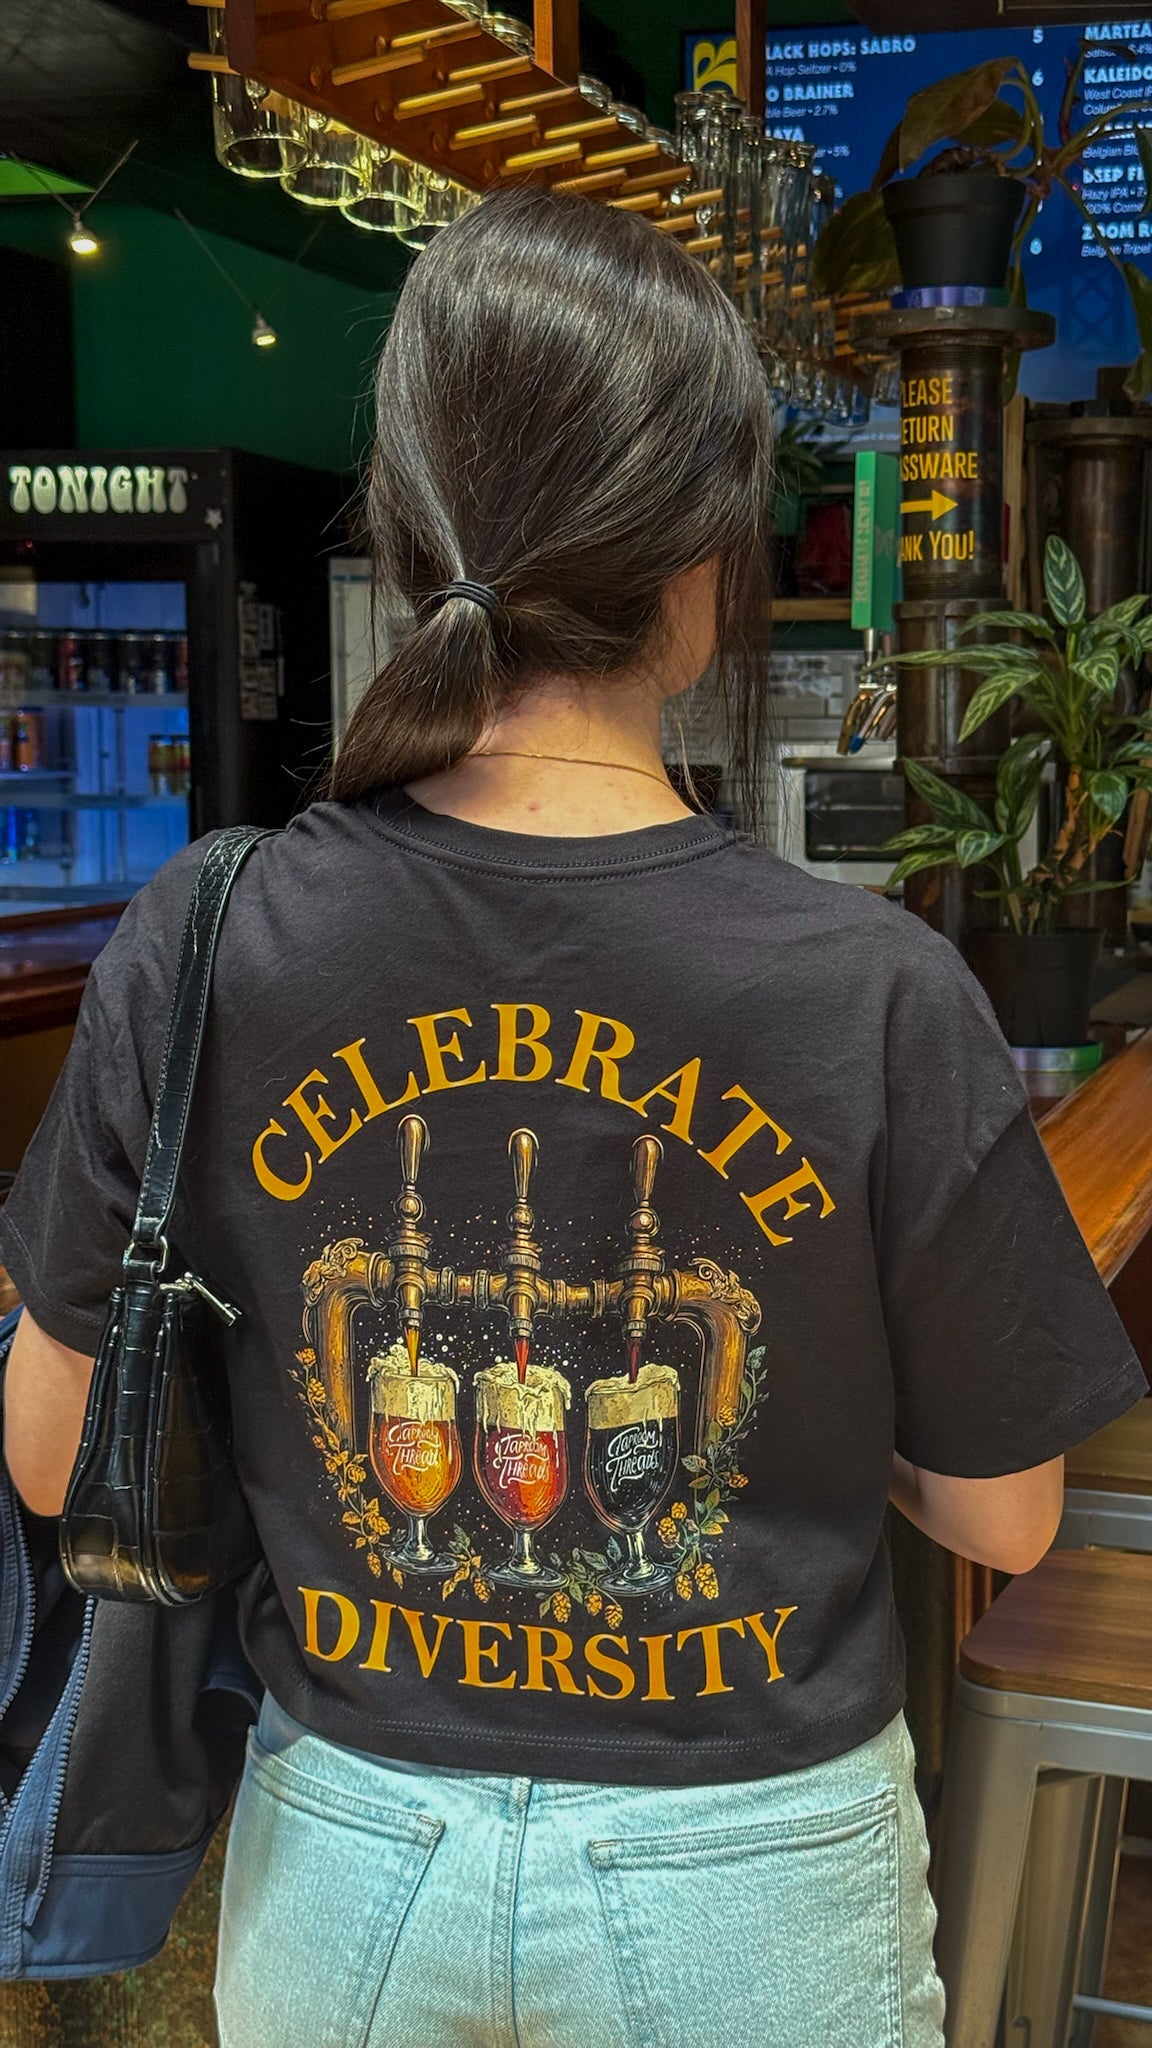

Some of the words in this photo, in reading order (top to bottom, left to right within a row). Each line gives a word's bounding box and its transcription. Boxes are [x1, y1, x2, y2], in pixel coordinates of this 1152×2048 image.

[765, 42, 805, 61] LACK
[808, 40, 857, 58] HOPS:
[860, 36, 917, 55] SABRO
[1032, 26, 1044, 44] 5
[765, 85, 780, 102] O
[783, 81, 855, 101] BRAINER
[1031, 68, 1044, 87] 6
[901, 415, 954, 446] ETURN
[901, 452, 978, 482] SSWARE
[9, 465, 188, 515] TONIGHT
[928, 529, 975, 562] YOU!
[252, 1003, 836, 1247] CELEBRATE
[300, 1586, 799, 1701] DIVERSITY
